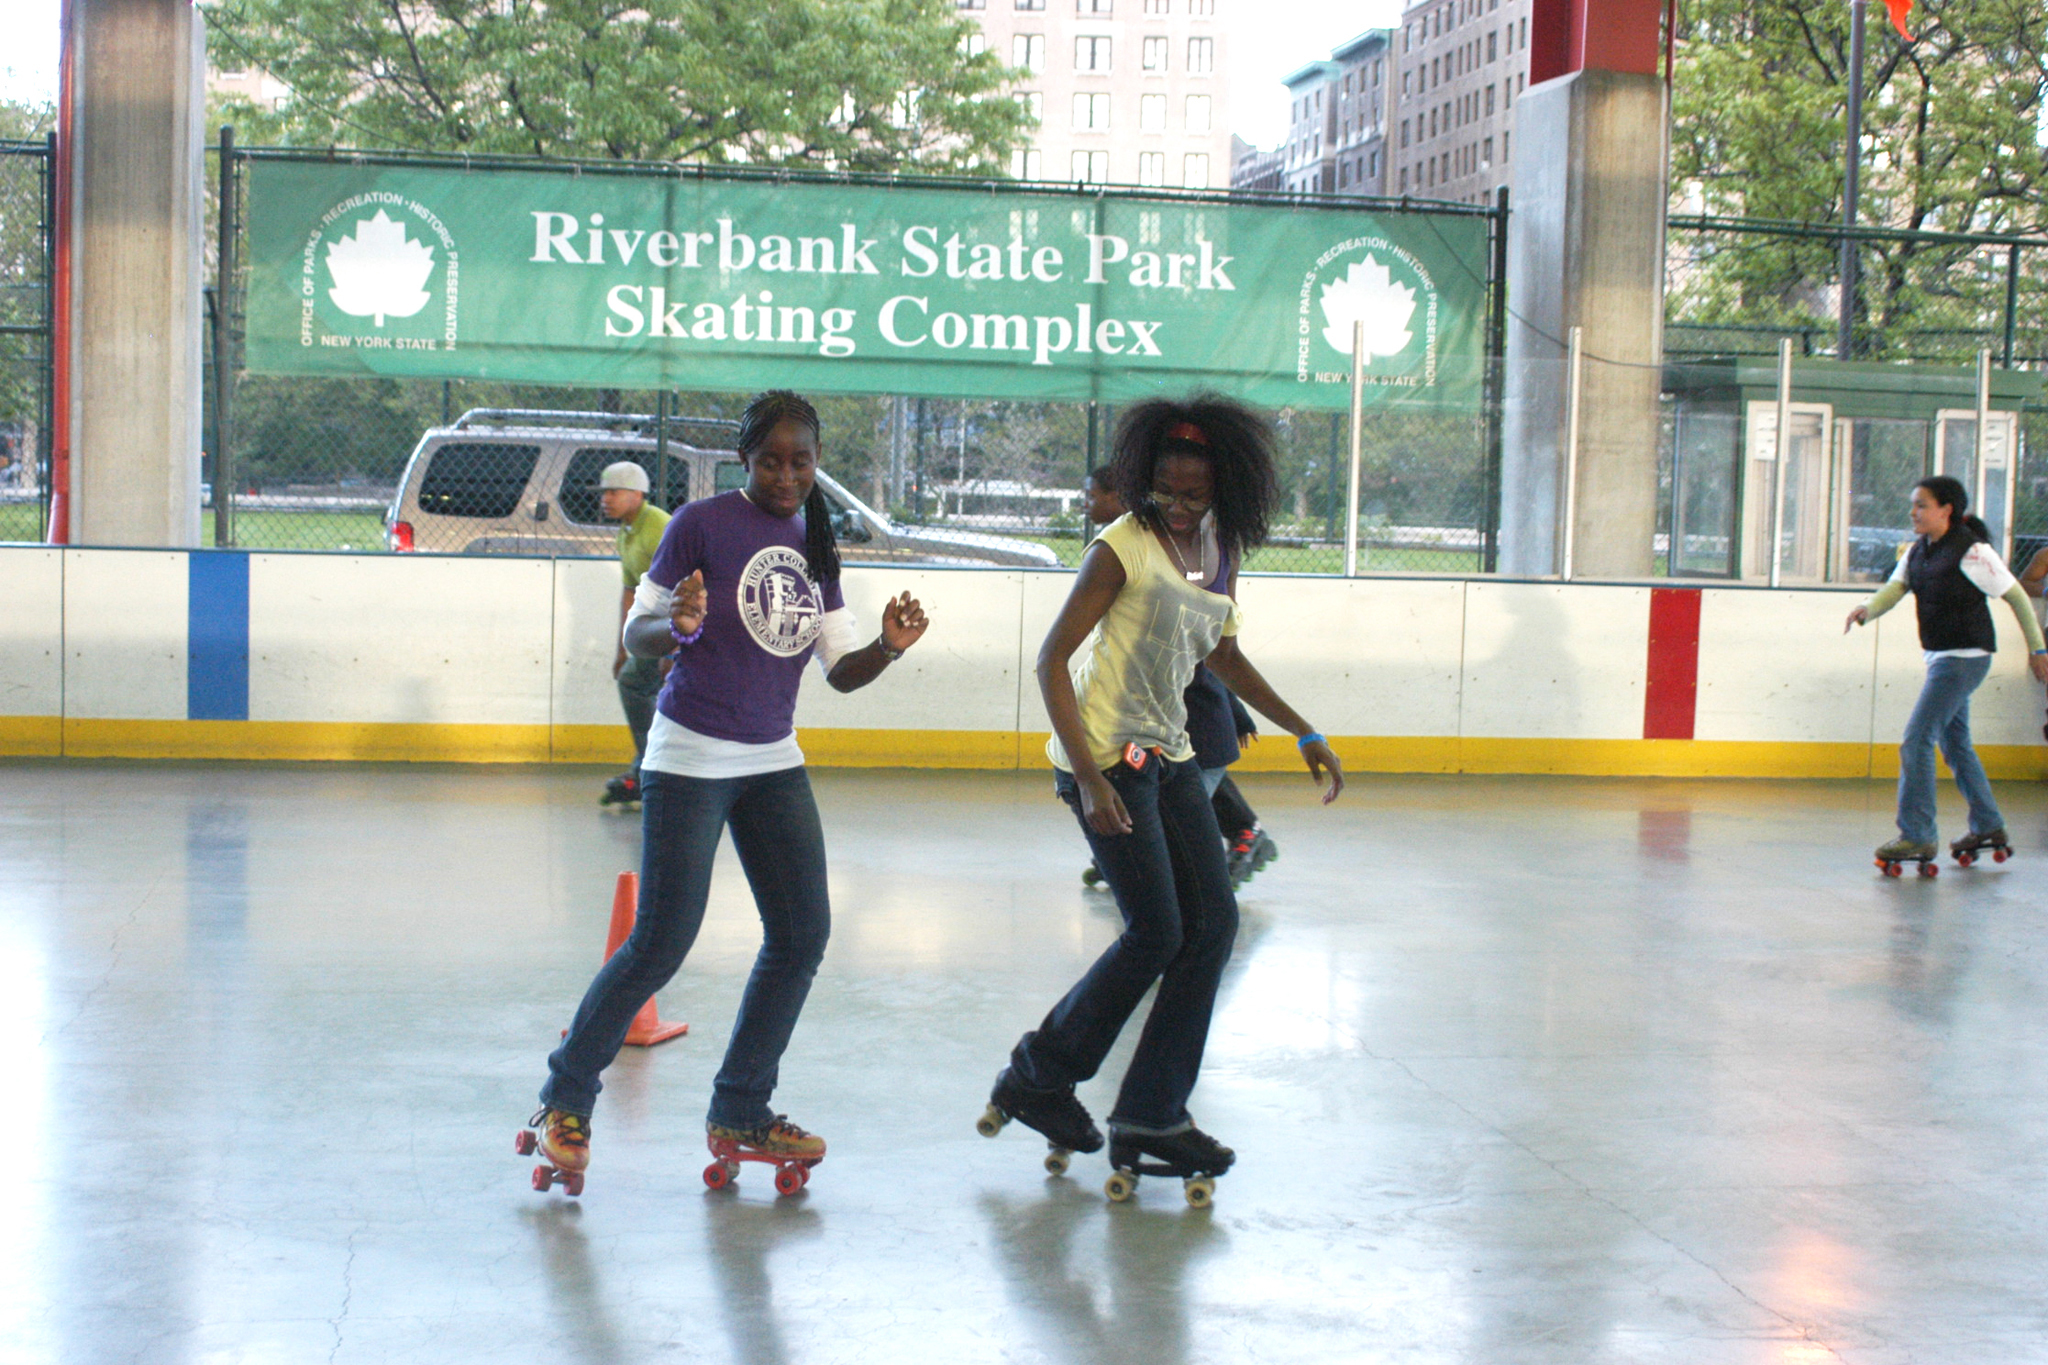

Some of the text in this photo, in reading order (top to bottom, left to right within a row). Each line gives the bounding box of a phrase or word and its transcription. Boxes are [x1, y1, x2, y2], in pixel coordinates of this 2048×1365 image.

[301, 191, 459, 351] OFFICE OF PARKS RECREATION HISTORIC PRESERVATION
[529, 211, 1236, 291] Riverbank State Park
[320, 335, 437, 351] NEW YORK STATE
[605, 284, 1163, 366] Skating Complex
[1297, 236, 1438, 387] OFFICE OF PARKS RECREATION HISTORIC PRESERVATION
[1315, 371, 1417, 387] NEW YRK STATE
[747, 553, 819, 594] HUNTER COLLE
